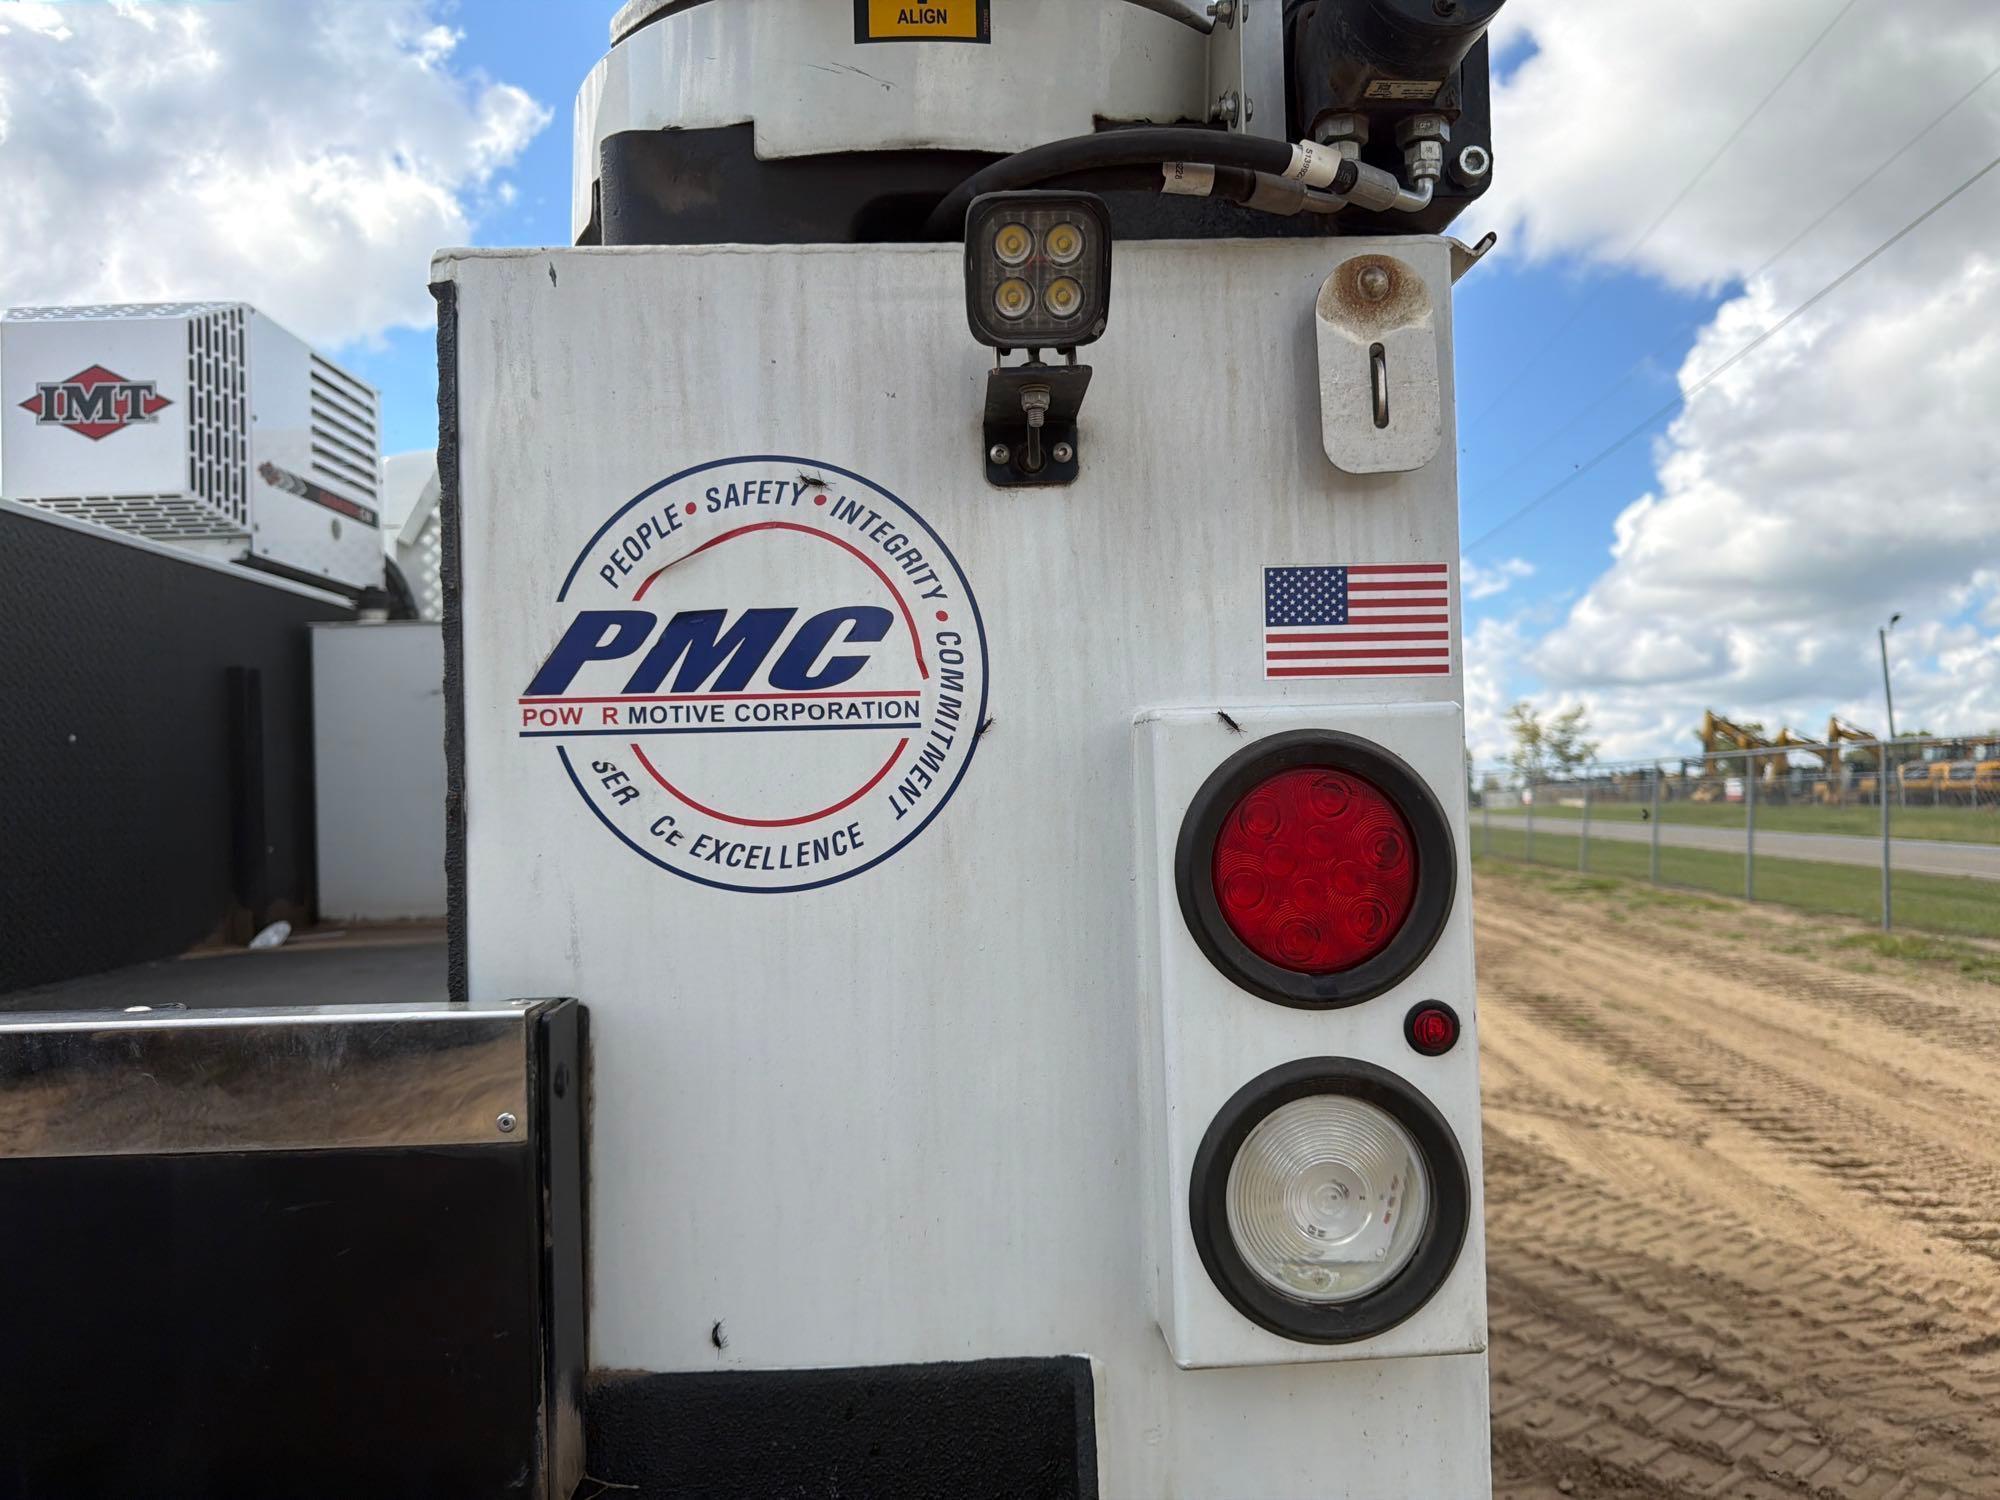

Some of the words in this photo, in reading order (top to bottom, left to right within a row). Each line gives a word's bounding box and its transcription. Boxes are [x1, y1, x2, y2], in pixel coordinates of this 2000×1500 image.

[897, 8, 948, 24] ALIGN
[39, 384, 154, 423] IMT
[705, 480, 807, 514] SAFETY
[599, 502, 683, 590] PEOPLE
[829, 495, 949, 600] INTEGRITY
[522, 605, 896, 697] PMC
[628, 704, 725, 725] MOTIVE
[734, 700, 920, 723] CORPORATION
[888, 631, 965, 821] COMMITMENT
[688, 821, 865, 871] EXCELLENCE
